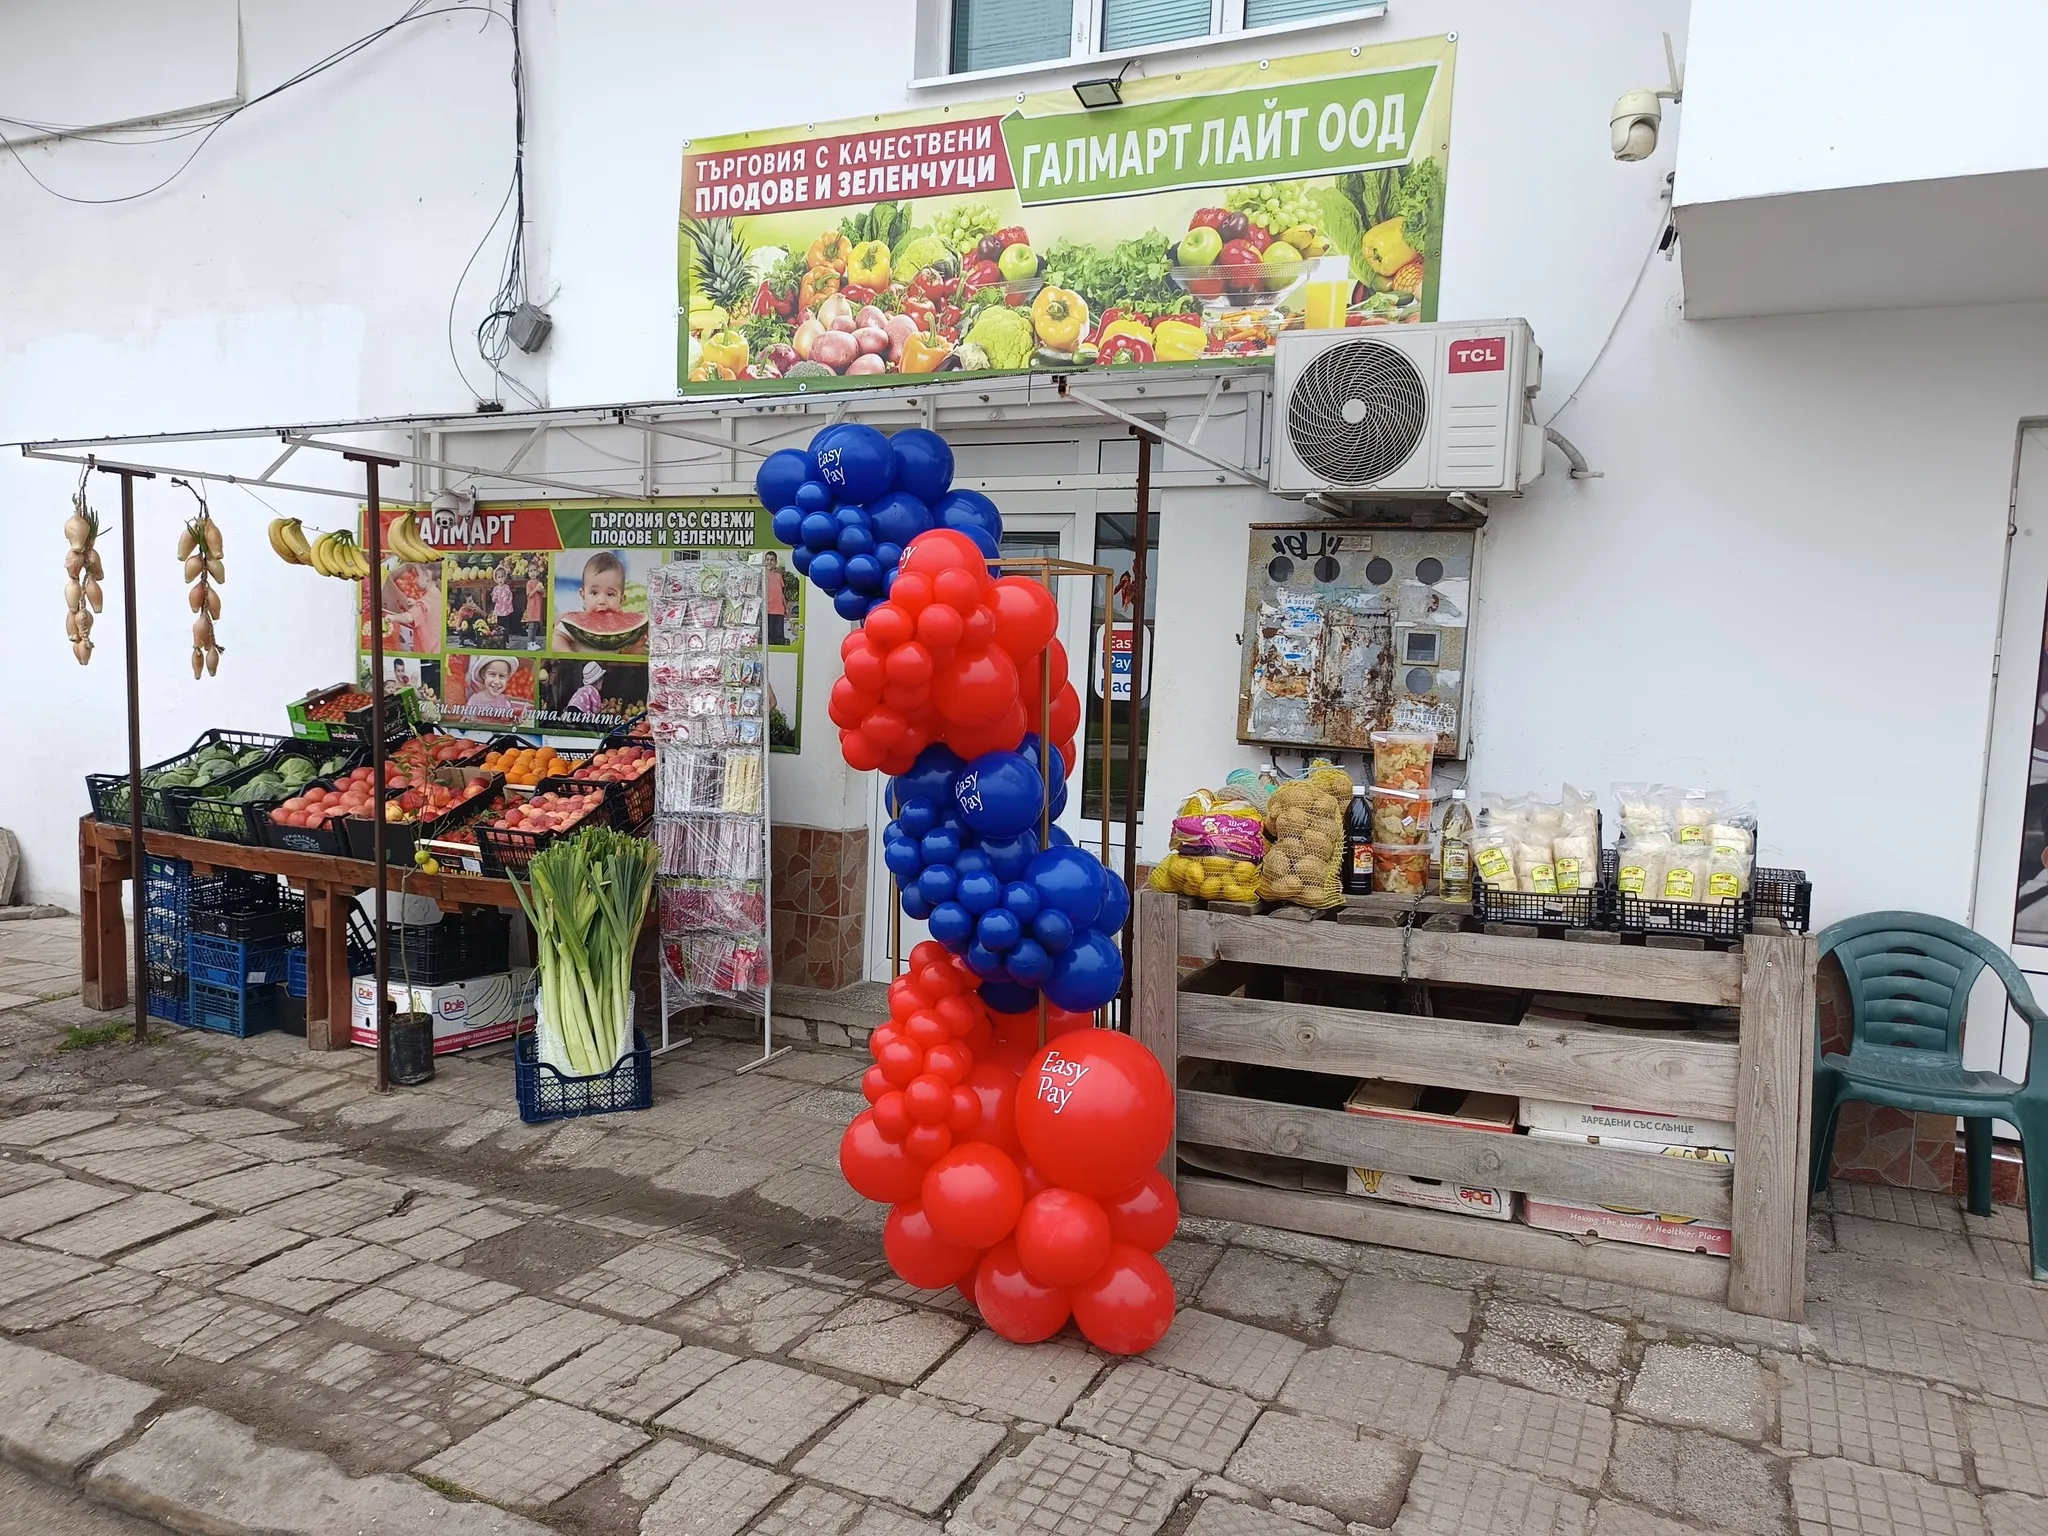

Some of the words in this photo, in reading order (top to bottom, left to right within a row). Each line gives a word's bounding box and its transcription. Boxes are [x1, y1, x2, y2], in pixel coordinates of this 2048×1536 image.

[695, 148, 806, 182] ТЪРГОВИЯ
[815, 144, 830, 169] С
[838, 125, 992, 166] КАЧЕСТВЕНИ
[1021, 123, 1192, 190] ГАЛМАРТ
[1198, 96, 1310, 167] ЛАЙТ
[1317, 94, 1407, 153] ООД
[695, 177, 810, 213] ПЛОДОВЕ
[814, 173, 831, 201] И
[837, 154, 996, 198] ЗЕЛЕНЧУЦИ
[1456, 349, 1497, 363] TCL
[817, 447, 843, 469] Easy
[822, 466, 846, 486] Pay
[415, 514, 515, 546] АЛМАРТ
[590, 511, 664, 529] ТЪРГОВИЯ
[667, 511, 697, 529] СЪС
[700, 511, 755, 529] СВЕЖИ
[590, 529, 652, 547] ПЛОДОВЕ
[657, 529, 667, 545] И
[673, 529, 755, 548] ЗЕЛЕНЧУЦИ
[899, 546, 918, 569] sy
[1111, 635, 1134, 649] Eas
[433, 701, 519, 722] зимнината,
[521, 708, 626, 726] витамините.
[955, 770, 979, 800] Easy
[960, 790, 983, 814] Pay
[358, 987, 374, 997] Dole
[443, 1000, 465, 1012] Dole
[1041, 1051, 1090, 1087] Easy
[1037, 1076, 1073, 1114] Pay
[1581, 1114, 1631, 1128] ЗАРЕДЕНИ
[1633, 1120, 1653, 1130] СЪС
[1654, 1123, 1695, 1135] СЛЪНЦЕ
[1460, 1189, 1492, 1206] Dole
[1570, 1213, 1599, 1226] Making
[1602, 1217, 1617, 1227] The
[1619, 1219, 1643, 1230] World
[1645, 1224, 1652, 1232] A
[1655, 1225, 1696, 1239] Healthier
